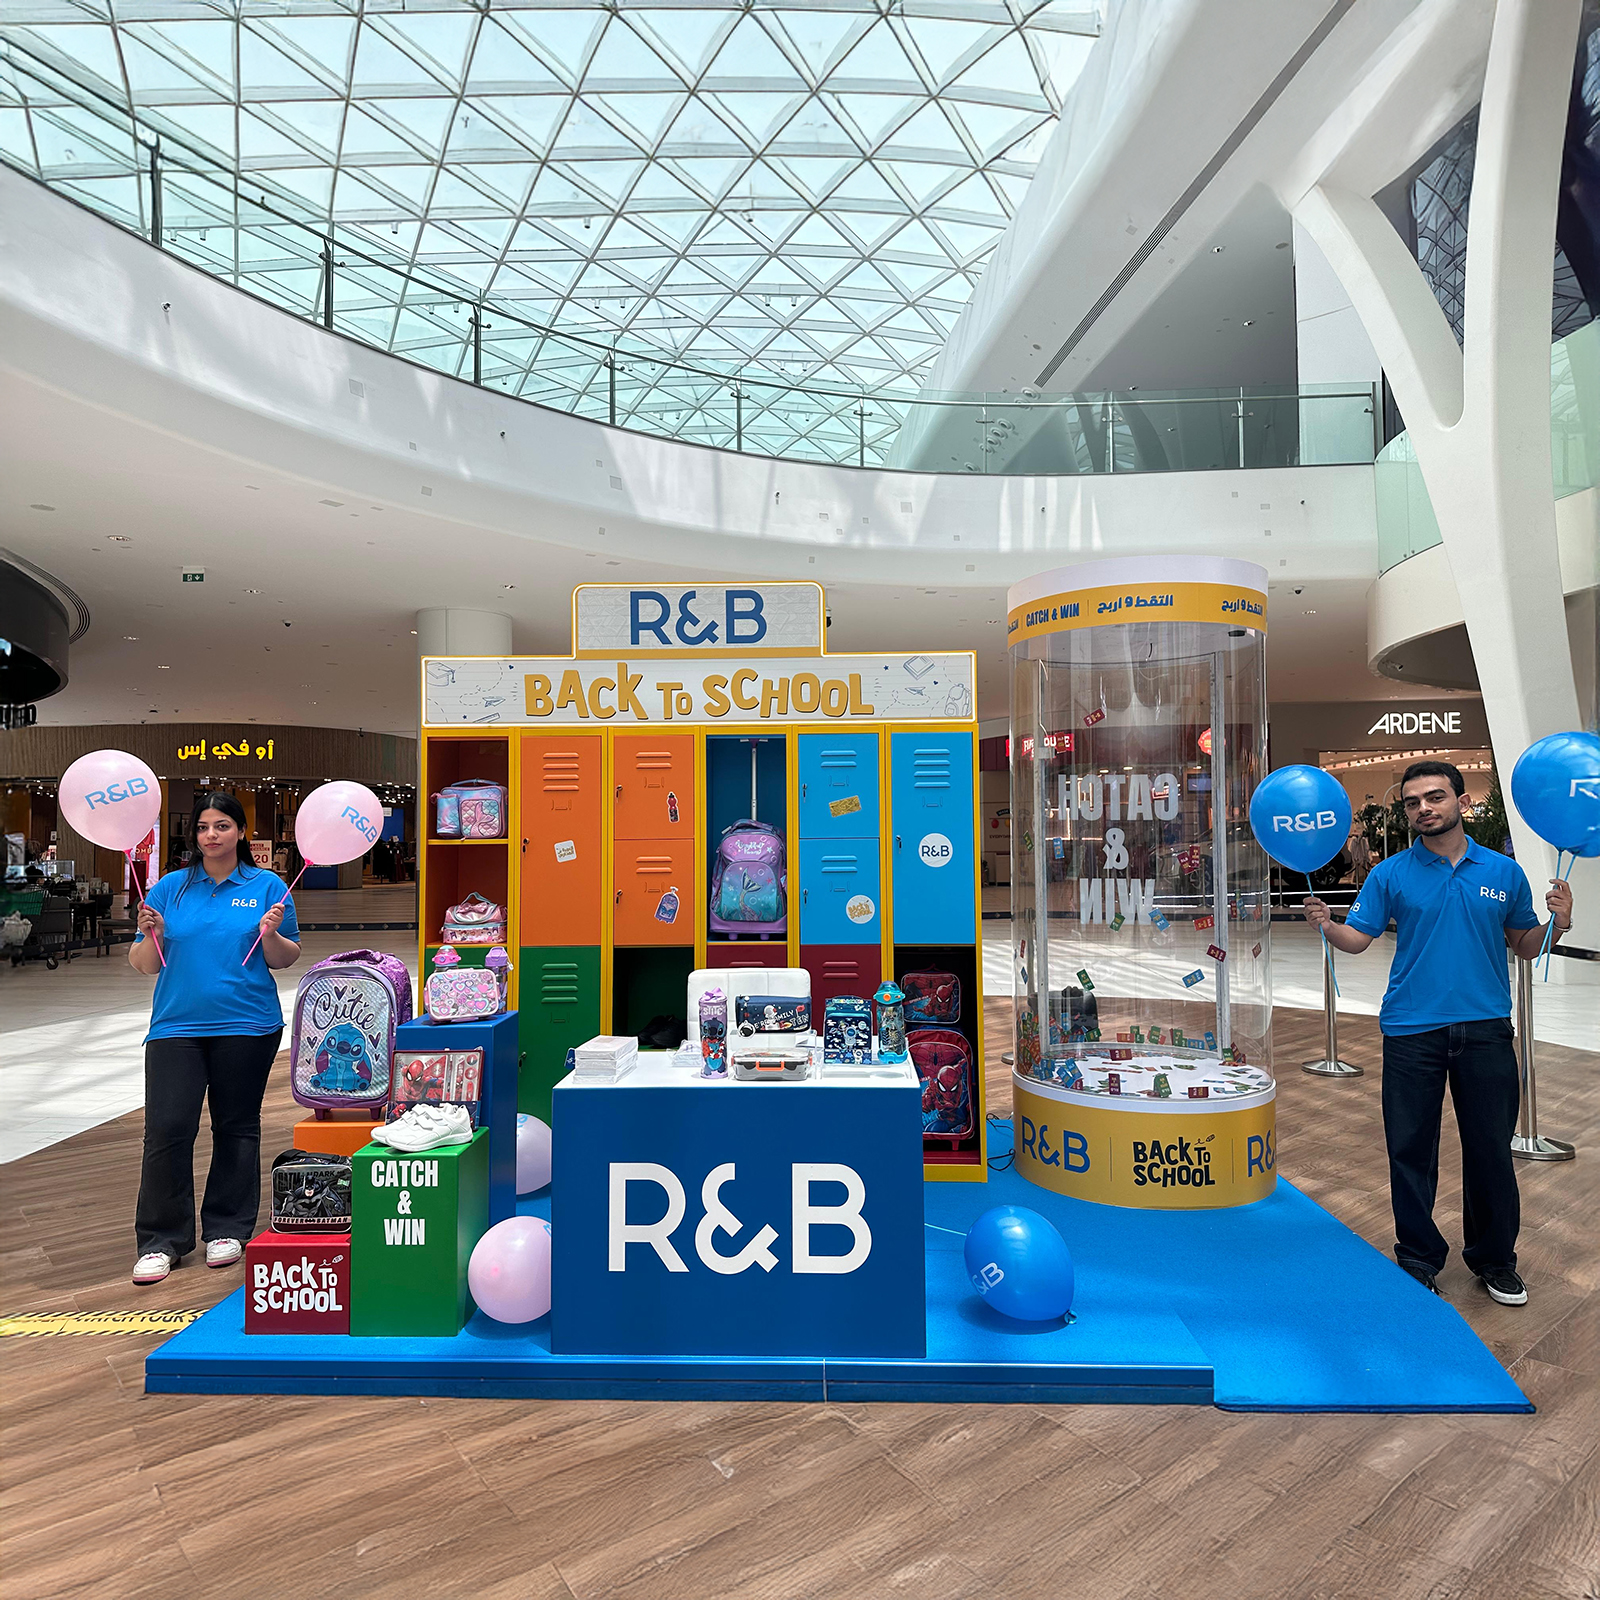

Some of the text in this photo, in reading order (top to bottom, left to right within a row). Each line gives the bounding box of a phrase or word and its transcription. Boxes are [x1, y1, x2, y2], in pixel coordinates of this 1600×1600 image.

[630, 589, 767, 645] R&B
[1026, 603, 1079, 627] CATCH & WIN
[524, 662, 648, 719] BACK
[702, 668, 874, 717] SCHOOL
[1367, 712, 1461, 734] ARDENE
[178, 739, 274, 760] أو في إس
[84, 778, 149, 810] R&B
[341, 806, 378, 843] R&B
[1273, 810, 1337, 832] R&B
[254, 854, 268, 863] 20
[922, 845, 950, 857] R&B
[231, 898, 258, 908] R&B
[1480, 886, 1506, 902] R&B
[313, 993, 375, 1030] Cutie
[703, 1005, 726, 1016] STITC
[1021, 1115, 1090, 1174] R&B
[1132, 1136, 1194, 1166] BACK
[1247, 1129, 1275, 1177] R&
[371, 1160, 438, 1187] CATCH
[1132, 1162, 1216, 1187] SCHOOL
[397, 1190, 412, 1214] &
[383, 1218, 425, 1246] WIN
[608, 1162, 872, 1275] R&B
[253, 1256, 318, 1288] BACK
[972, 1262, 1005, 1295] &B
[253, 1285, 342, 1313] SCHOOL
